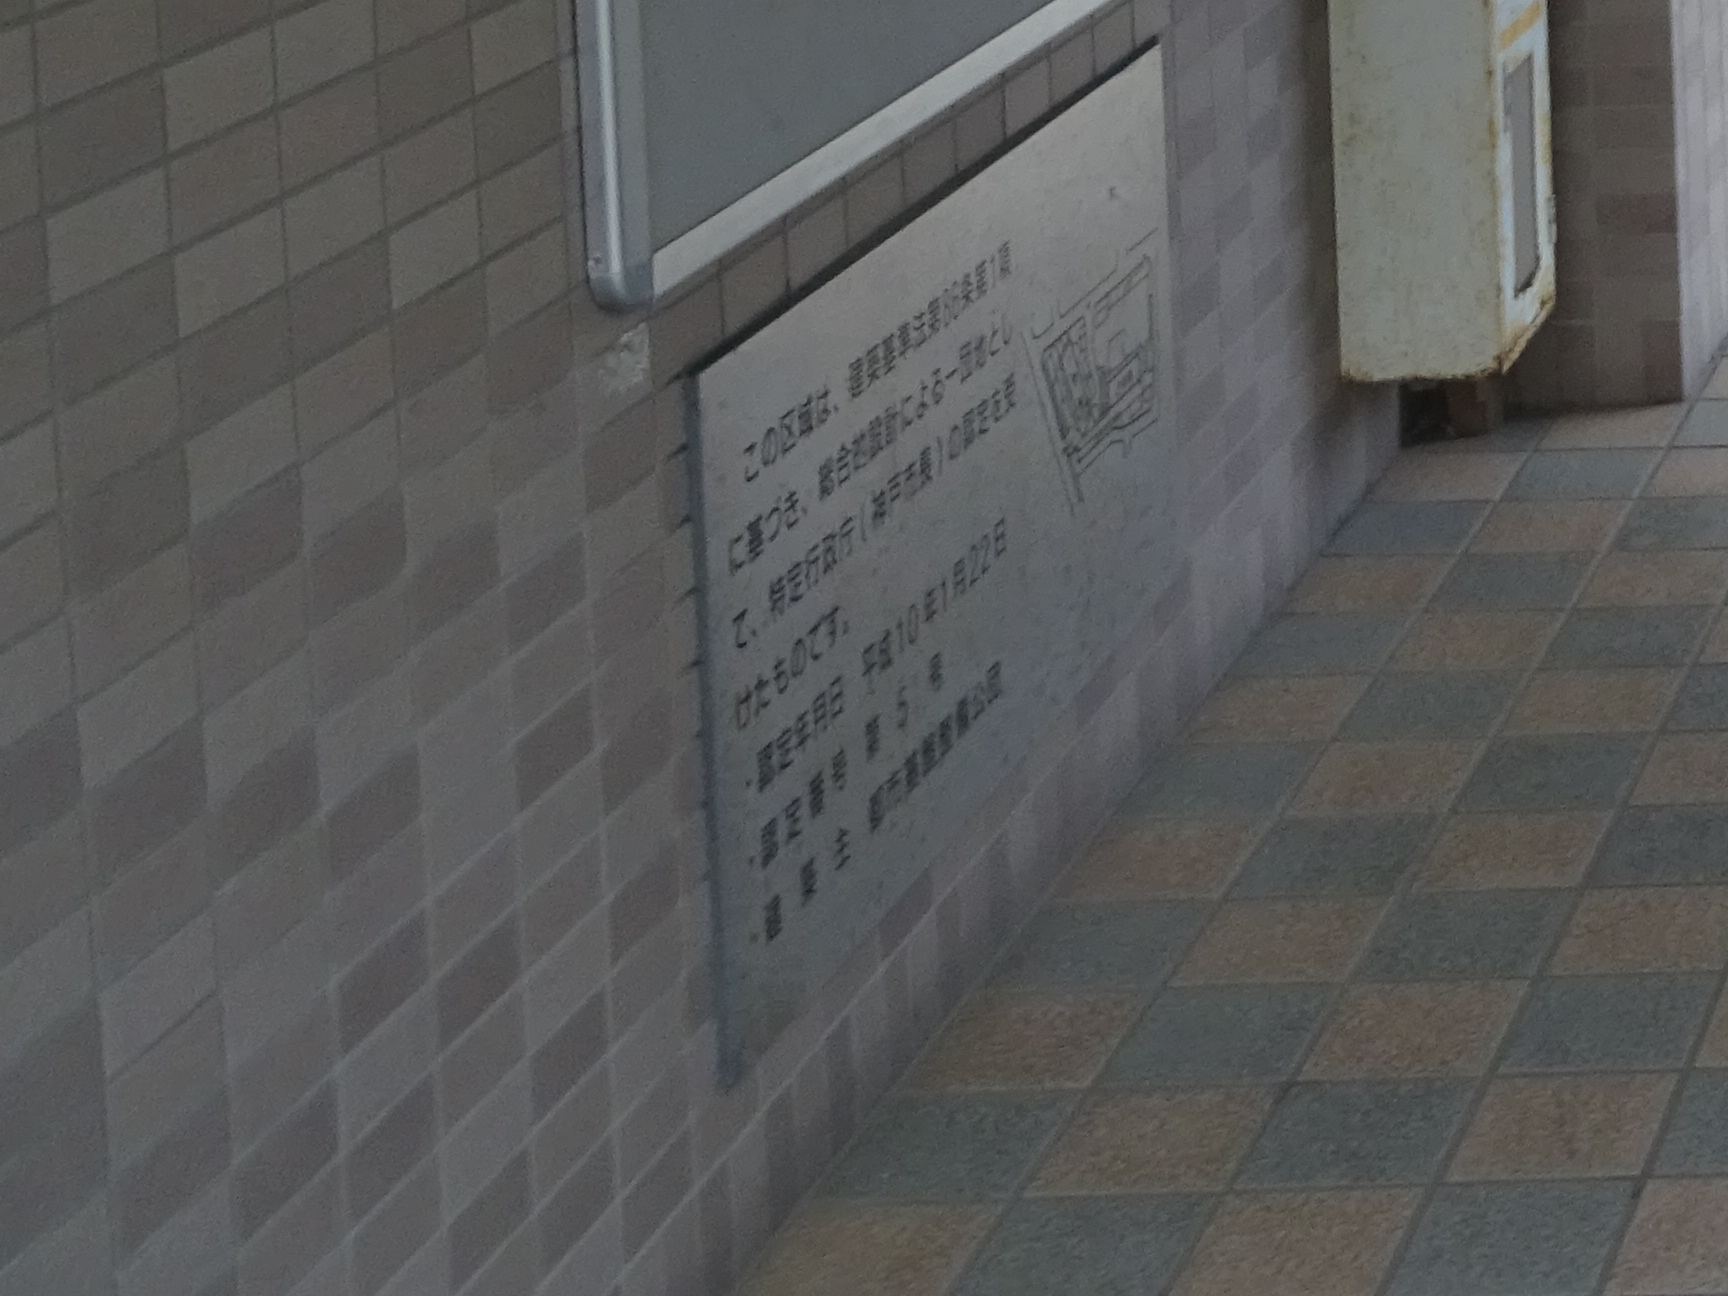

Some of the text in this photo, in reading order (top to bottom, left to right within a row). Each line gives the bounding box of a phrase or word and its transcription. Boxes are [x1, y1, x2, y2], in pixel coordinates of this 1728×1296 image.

[735, 593, 850, 734] けたものです。
